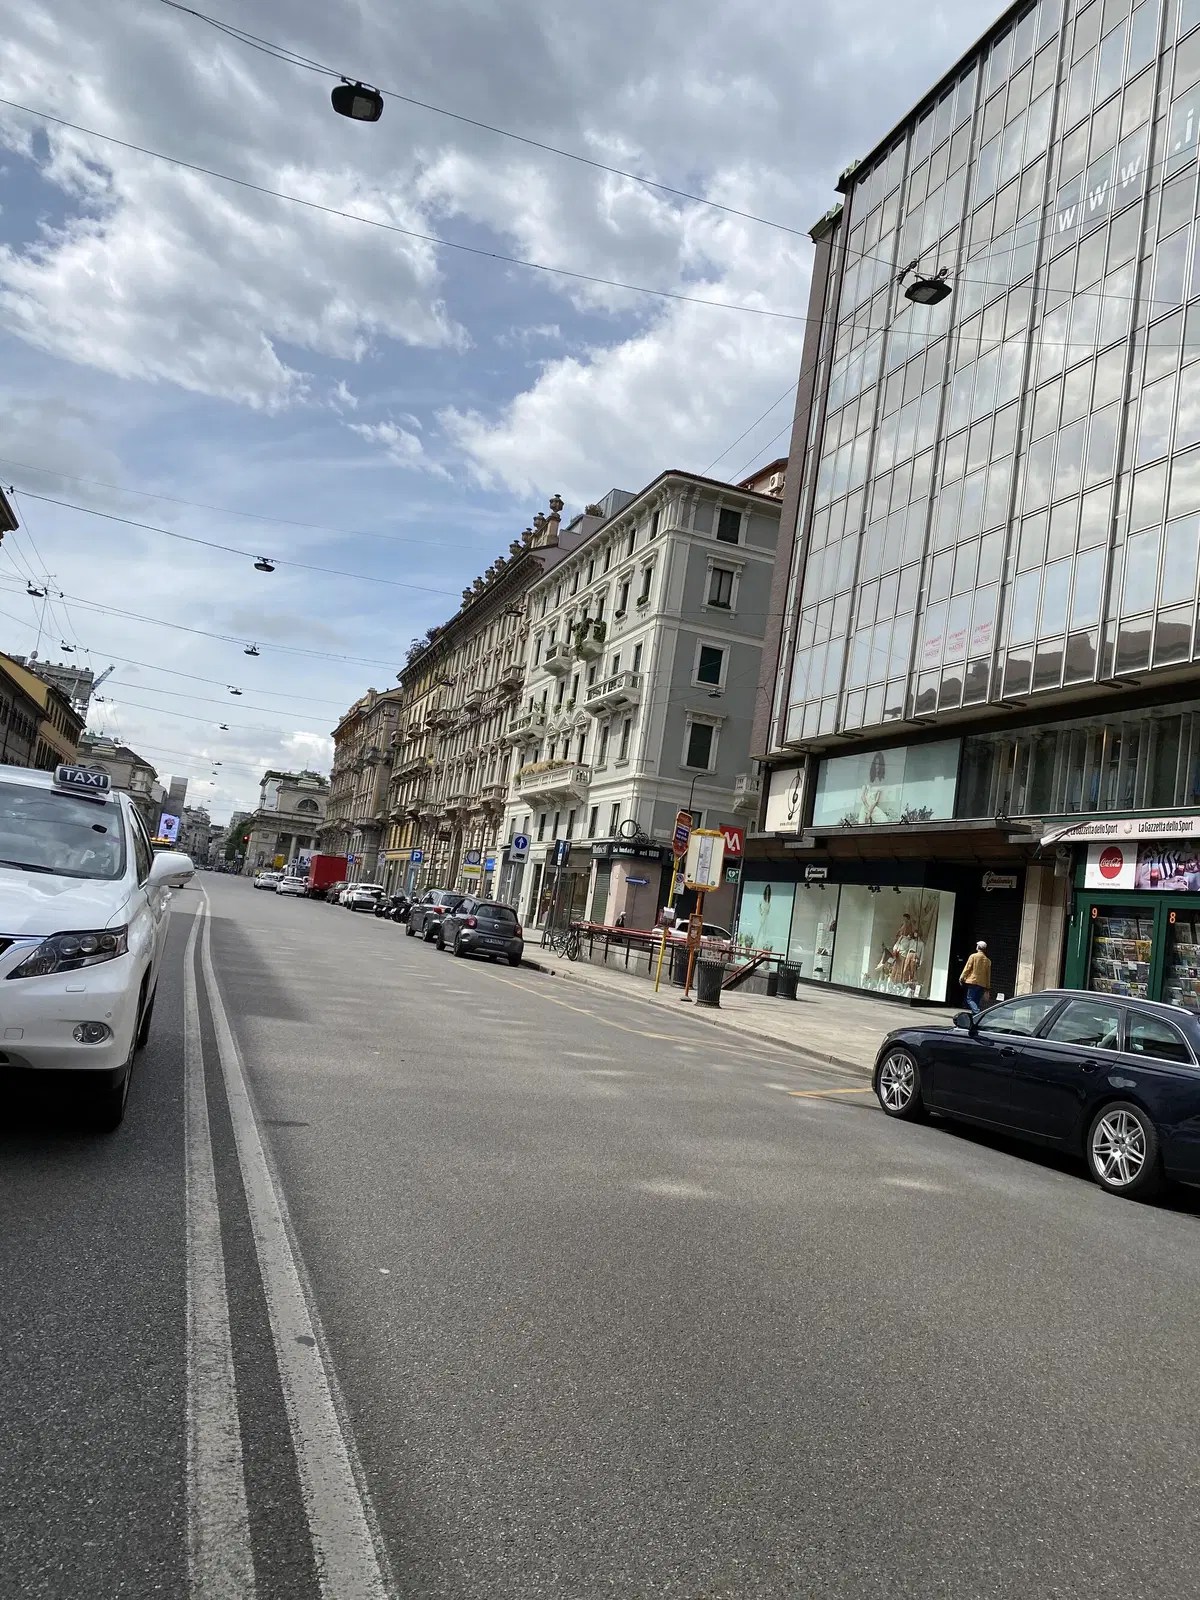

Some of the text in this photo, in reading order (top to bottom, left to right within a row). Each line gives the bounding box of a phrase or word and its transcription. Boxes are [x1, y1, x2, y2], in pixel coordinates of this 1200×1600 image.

[63, 769, 104, 786] TAXI
[1179, 820, 1193, 833] Sport
[413, 852, 421, 861] P
[1091, 908, 1098, 919] 9
[1169, 912, 1176, 924] 8
